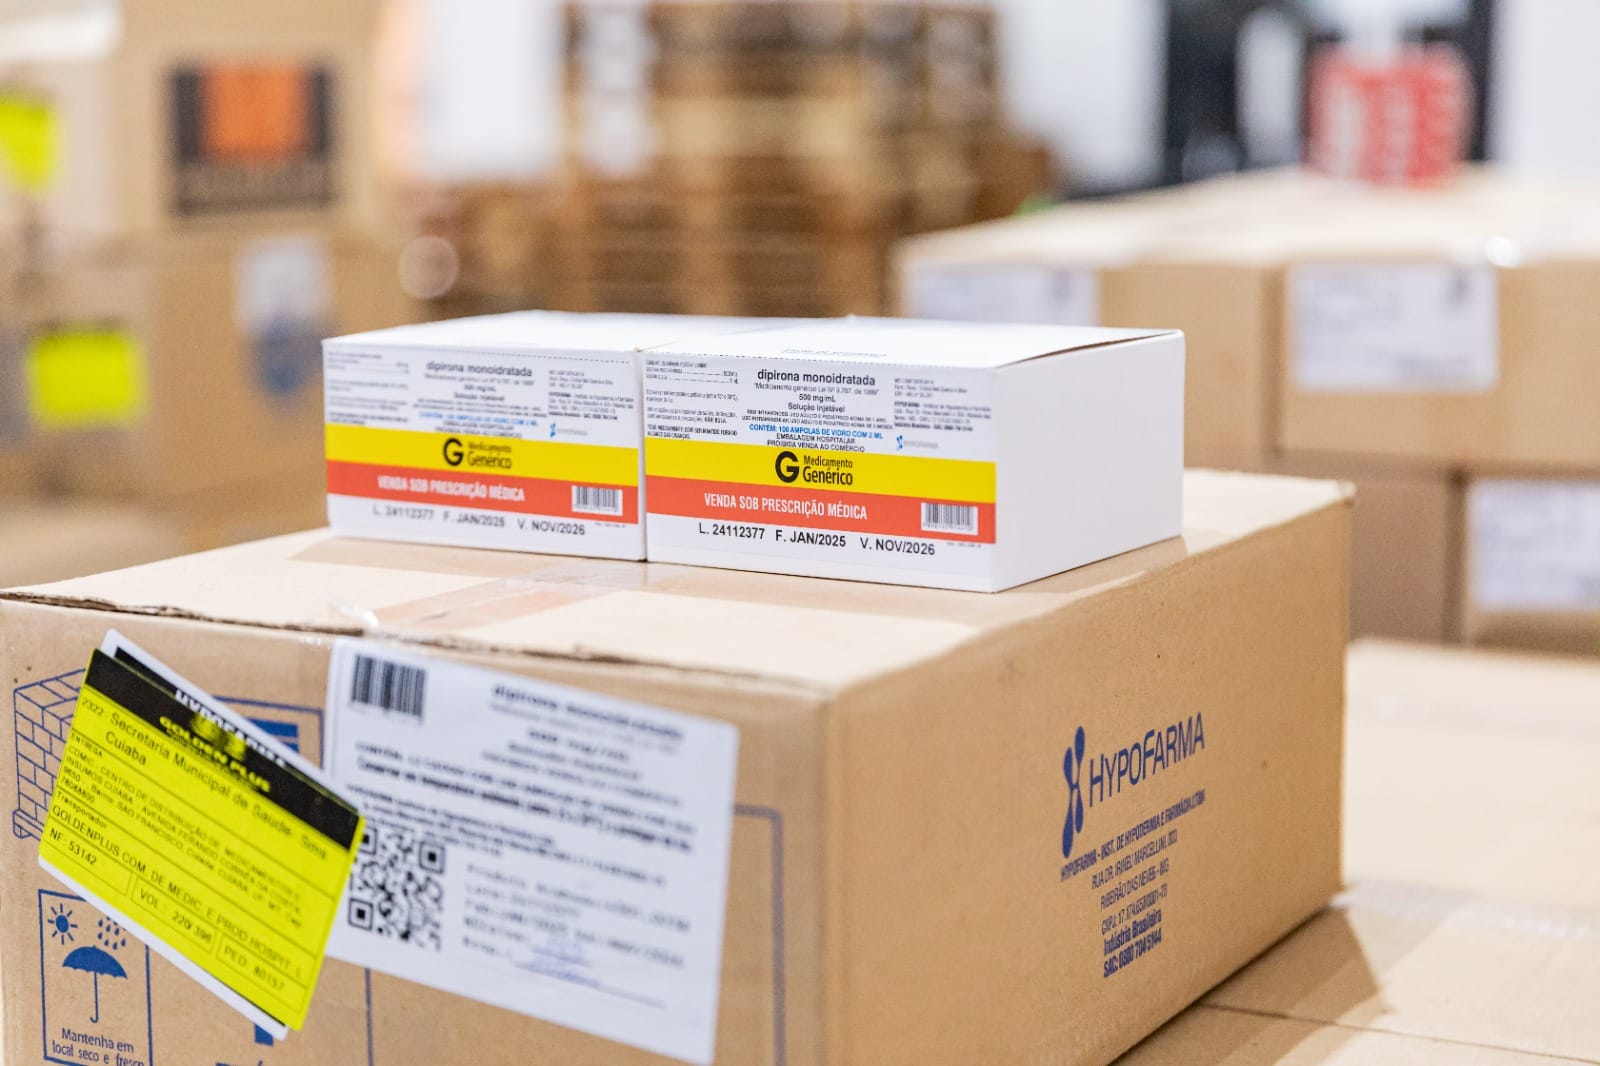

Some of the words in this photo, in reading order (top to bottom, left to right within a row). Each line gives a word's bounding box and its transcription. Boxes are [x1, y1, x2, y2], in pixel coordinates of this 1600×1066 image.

[426, 361, 464, 372] dipirona
[467, 365, 532, 376] monoidratada
[758, 369, 799, 382] dipirona
[803, 373, 875, 385] monoidratada
[767, 440, 796, 448] PROIBIDA
[777, 433, 815, 441] EMBALAGEM
[817, 436, 855, 444] HOSPITALAR
[790, 427, 820, 435] AMPOLAS
[852, 430, 867, 438] COM
[443, 438, 464, 466] G
[804, 455, 853, 468] Medicamento
[775, 451, 799, 483] G
[803, 466, 853, 485] Genérico
[704, 492, 736, 508] VENDA
[739, 495, 758, 510] SOB
[762, 498, 824, 517] PRESCRIÇÃO
[828, 501, 867, 519] MÉDICA
[386, 505, 435, 519] 24112377
[457, 512, 505, 527] JAN/2025
[532, 520, 585, 535] NOV/2026
[713, 524, 765, 539] 24112377
[790, 531, 846, 547] JAN/2025
[876, 538, 935, 555] NOV/2026
[104, 729, 148, 767] Cuiaba
[109, 710, 171, 760] Secretaria
[171, 751, 230, 801] Municipal
[232, 789, 249, 810] de
[1090, 712, 1205, 807] HYPOFARMA
[51, 803, 120, 857] GOLDENPLUS
[149, 869, 166, 888] DE
[67, 839, 97, 867] 53142
[1116, 833, 1124, 851] DE
[1132, 904, 1161, 938] Brasileira
[53, 1041, 74, 1057] local
[79, 1049, 99, 1062] seco
[103, 1055, 109, 1064] e
[62, 1028, 114, 1049] Mantenha
[117, 1042, 134, 1053] em
